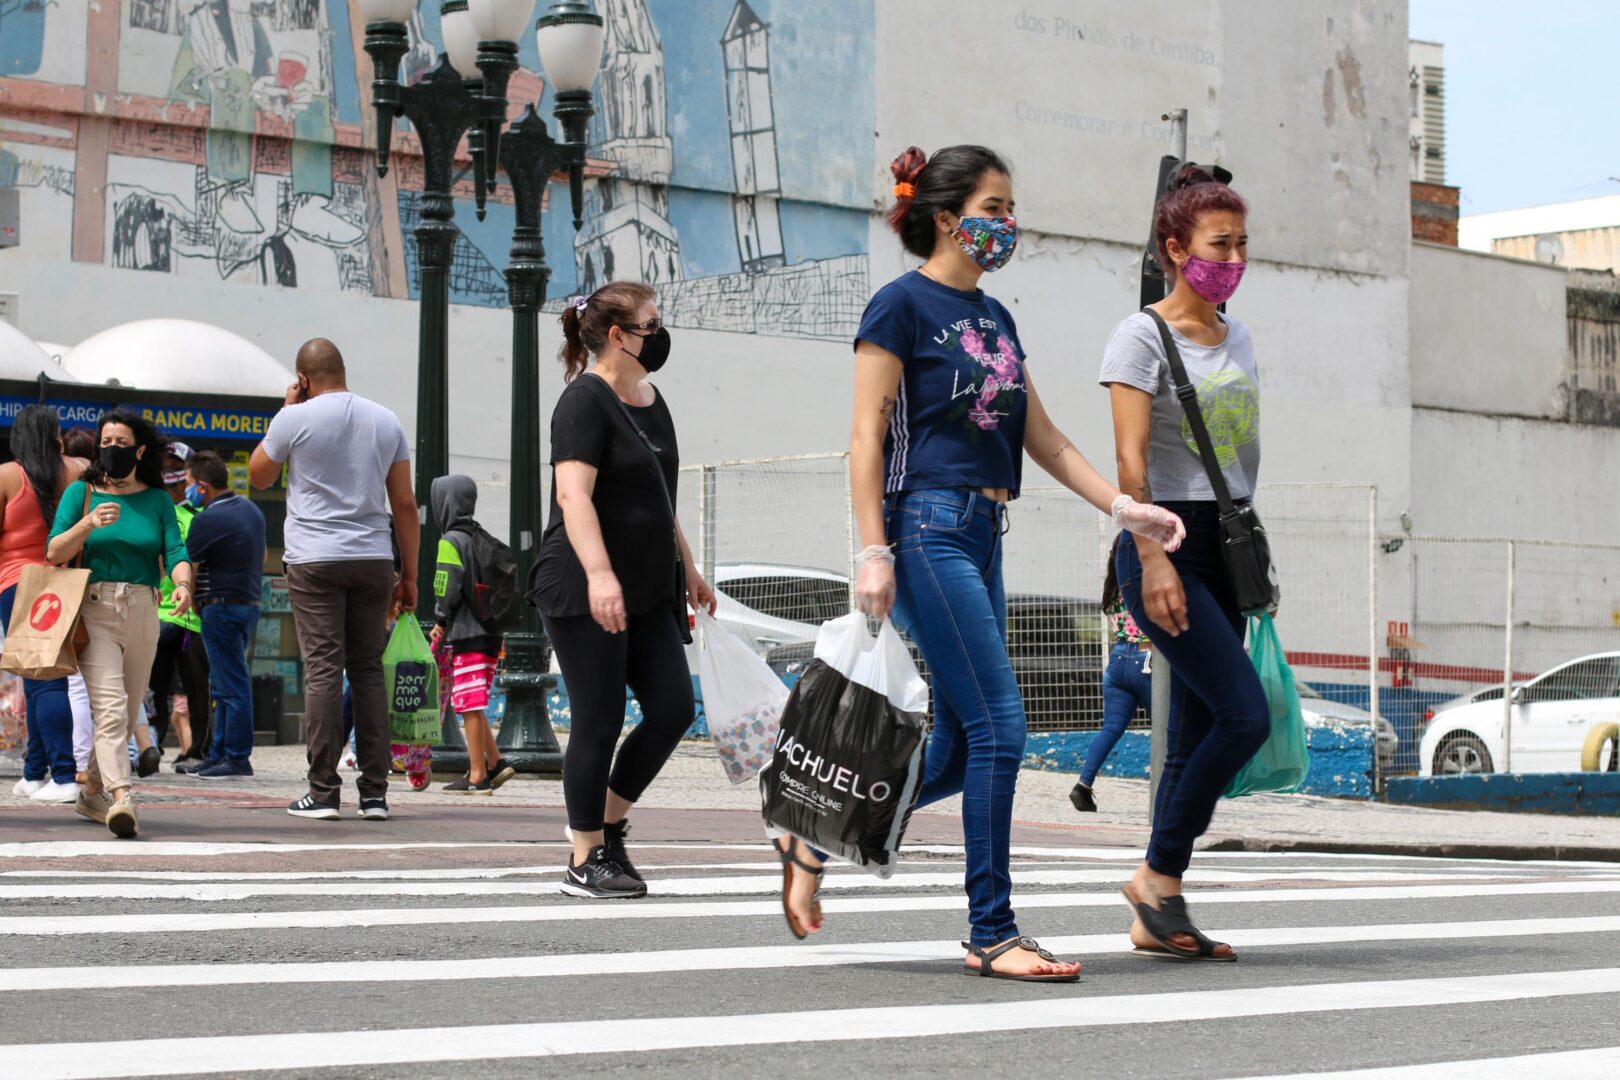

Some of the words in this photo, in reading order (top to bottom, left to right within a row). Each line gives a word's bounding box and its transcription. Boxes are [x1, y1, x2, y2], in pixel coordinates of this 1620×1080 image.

[1014, 10, 1046, 35] dos
[1123, 30, 1144, 52] de
[933, 328, 950, 344] LA
[950, 319, 973, 332] VIE
[978, 318, 997, 331] EST
[143, 408, 206, 430] BANCA
[211, 413, 273, 434] MOREI
[396, 686, 418, 695] me
